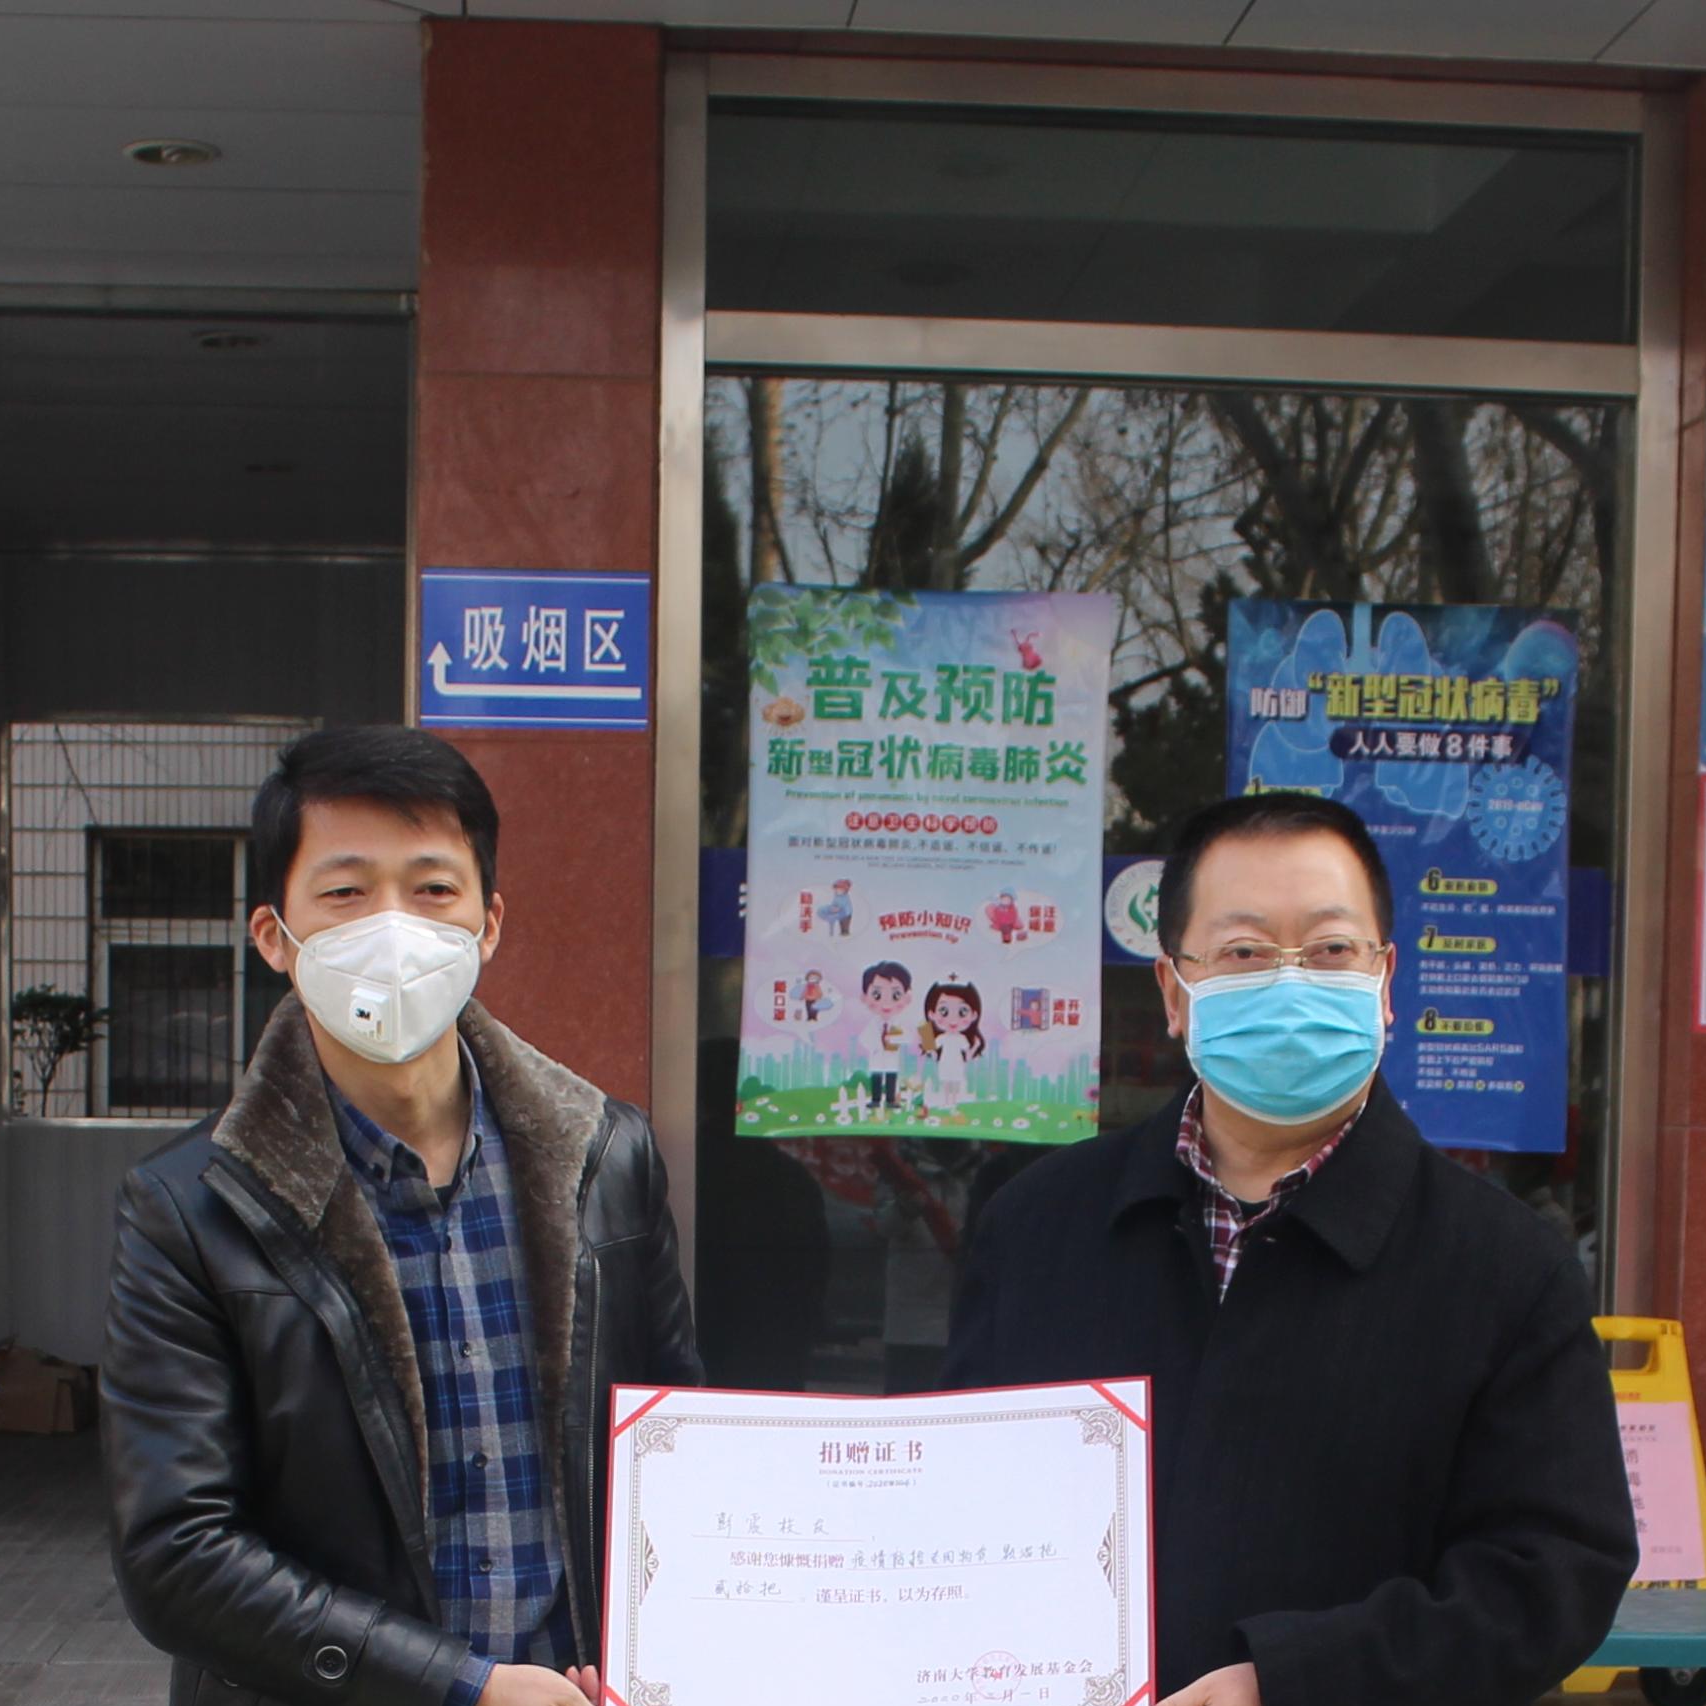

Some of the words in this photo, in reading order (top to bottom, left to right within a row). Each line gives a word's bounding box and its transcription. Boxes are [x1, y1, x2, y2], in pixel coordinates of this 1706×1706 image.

[463, 605, 627, 673] 吸烟区
[805, 654, 1057, 726] 普及预防
[1349, 731, 1514, 759] 人人要做8件事
[765, 734, 1089, 786] 新型冠状病毒肺炎
[1427, 868, 1441, 892] 6
[878, 909, 973, 935] 预防小知识
[1424, 927, 1438, 949] 7
[1424, 1009, 1437, 1031] 8
[818, 1439, 925, 1465] 捐赠证书
[729, 1550, 845, 1570] 感谢您慷慨捐赠
[915, 1658, 1094, 1685] 济南大学教育发展基金会
